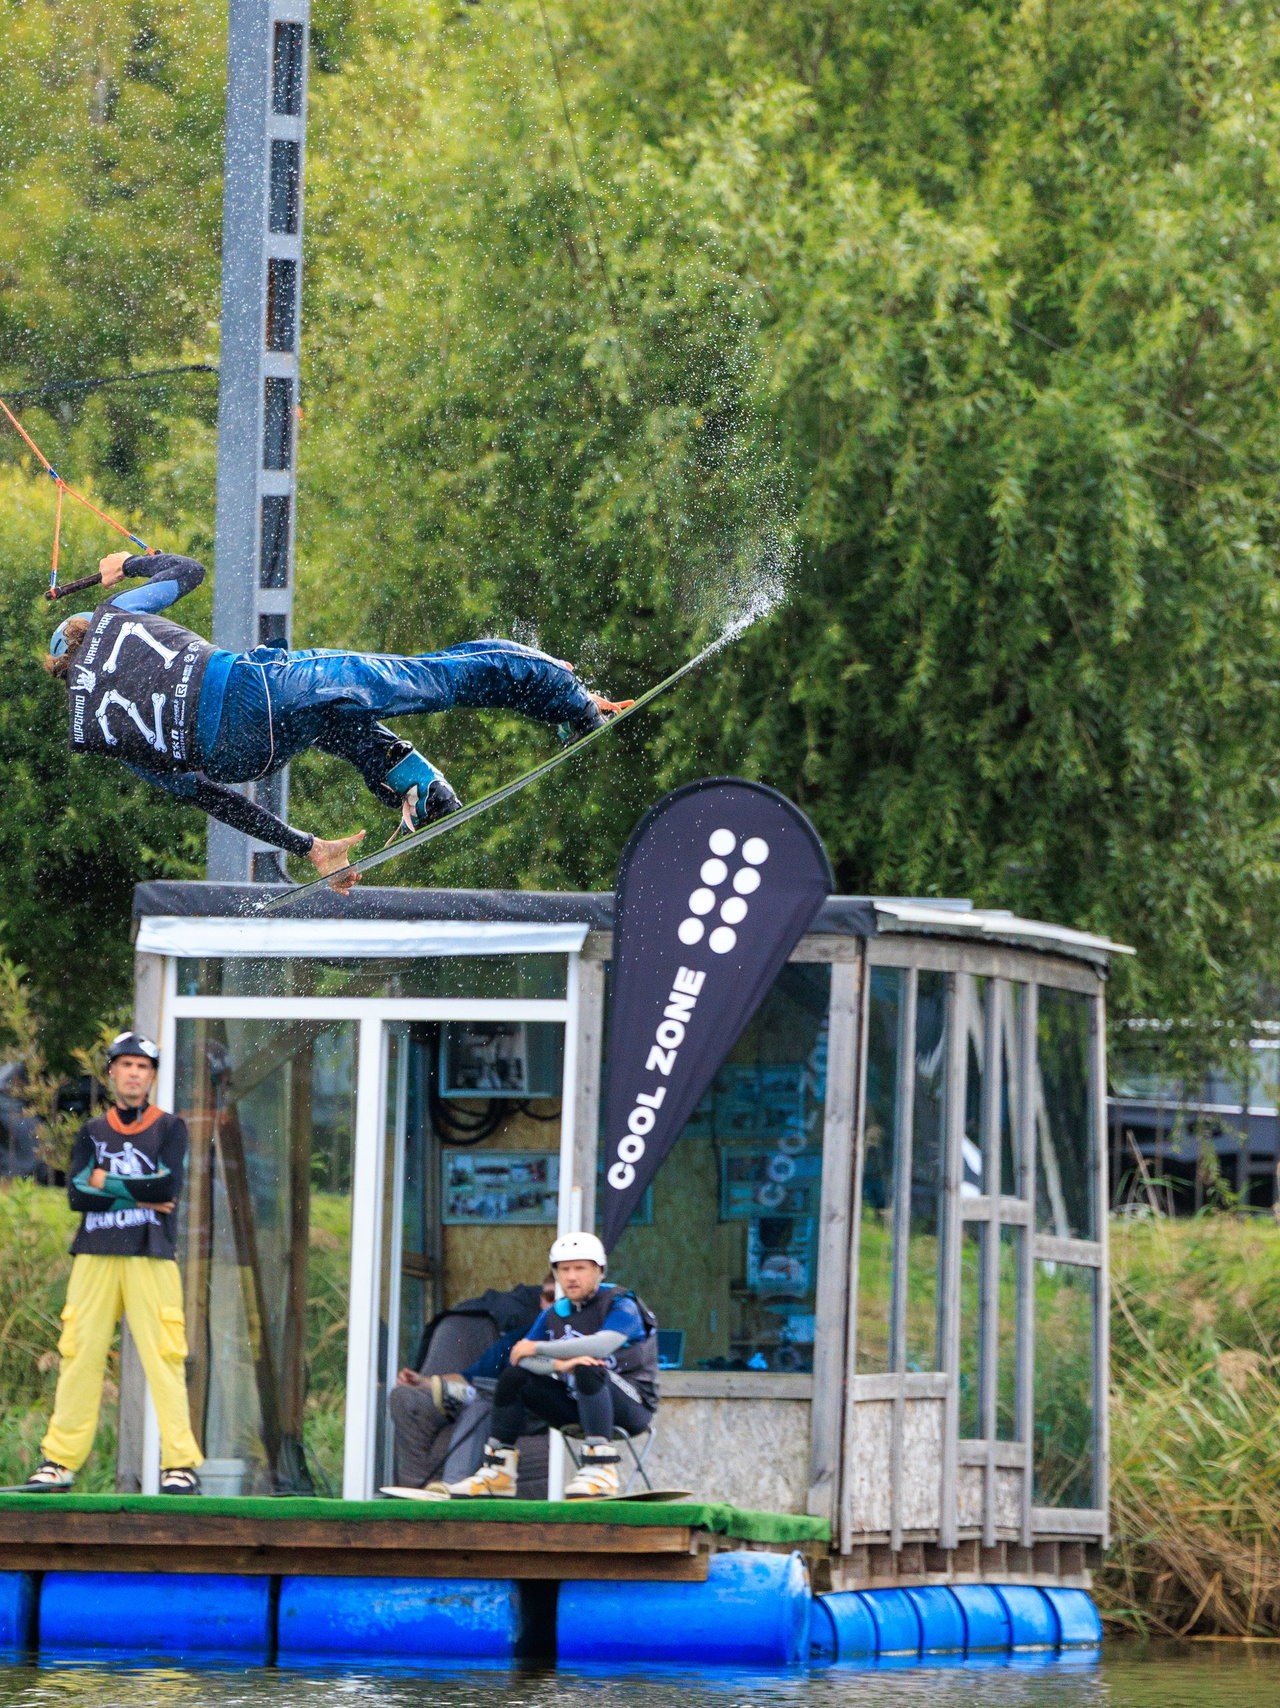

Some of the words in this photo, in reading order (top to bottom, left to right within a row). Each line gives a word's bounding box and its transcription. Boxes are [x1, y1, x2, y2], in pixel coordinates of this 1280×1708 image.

[84, 637, 101, 665] WAKE
[95, 612, 116, 637] PARK
[95, 621, 181, 753] 27
[607, 1086, 666, 1190] COOL
[645, 965, 707, 1077] ZONE
[758, 1109, 819, 1208] COOL
